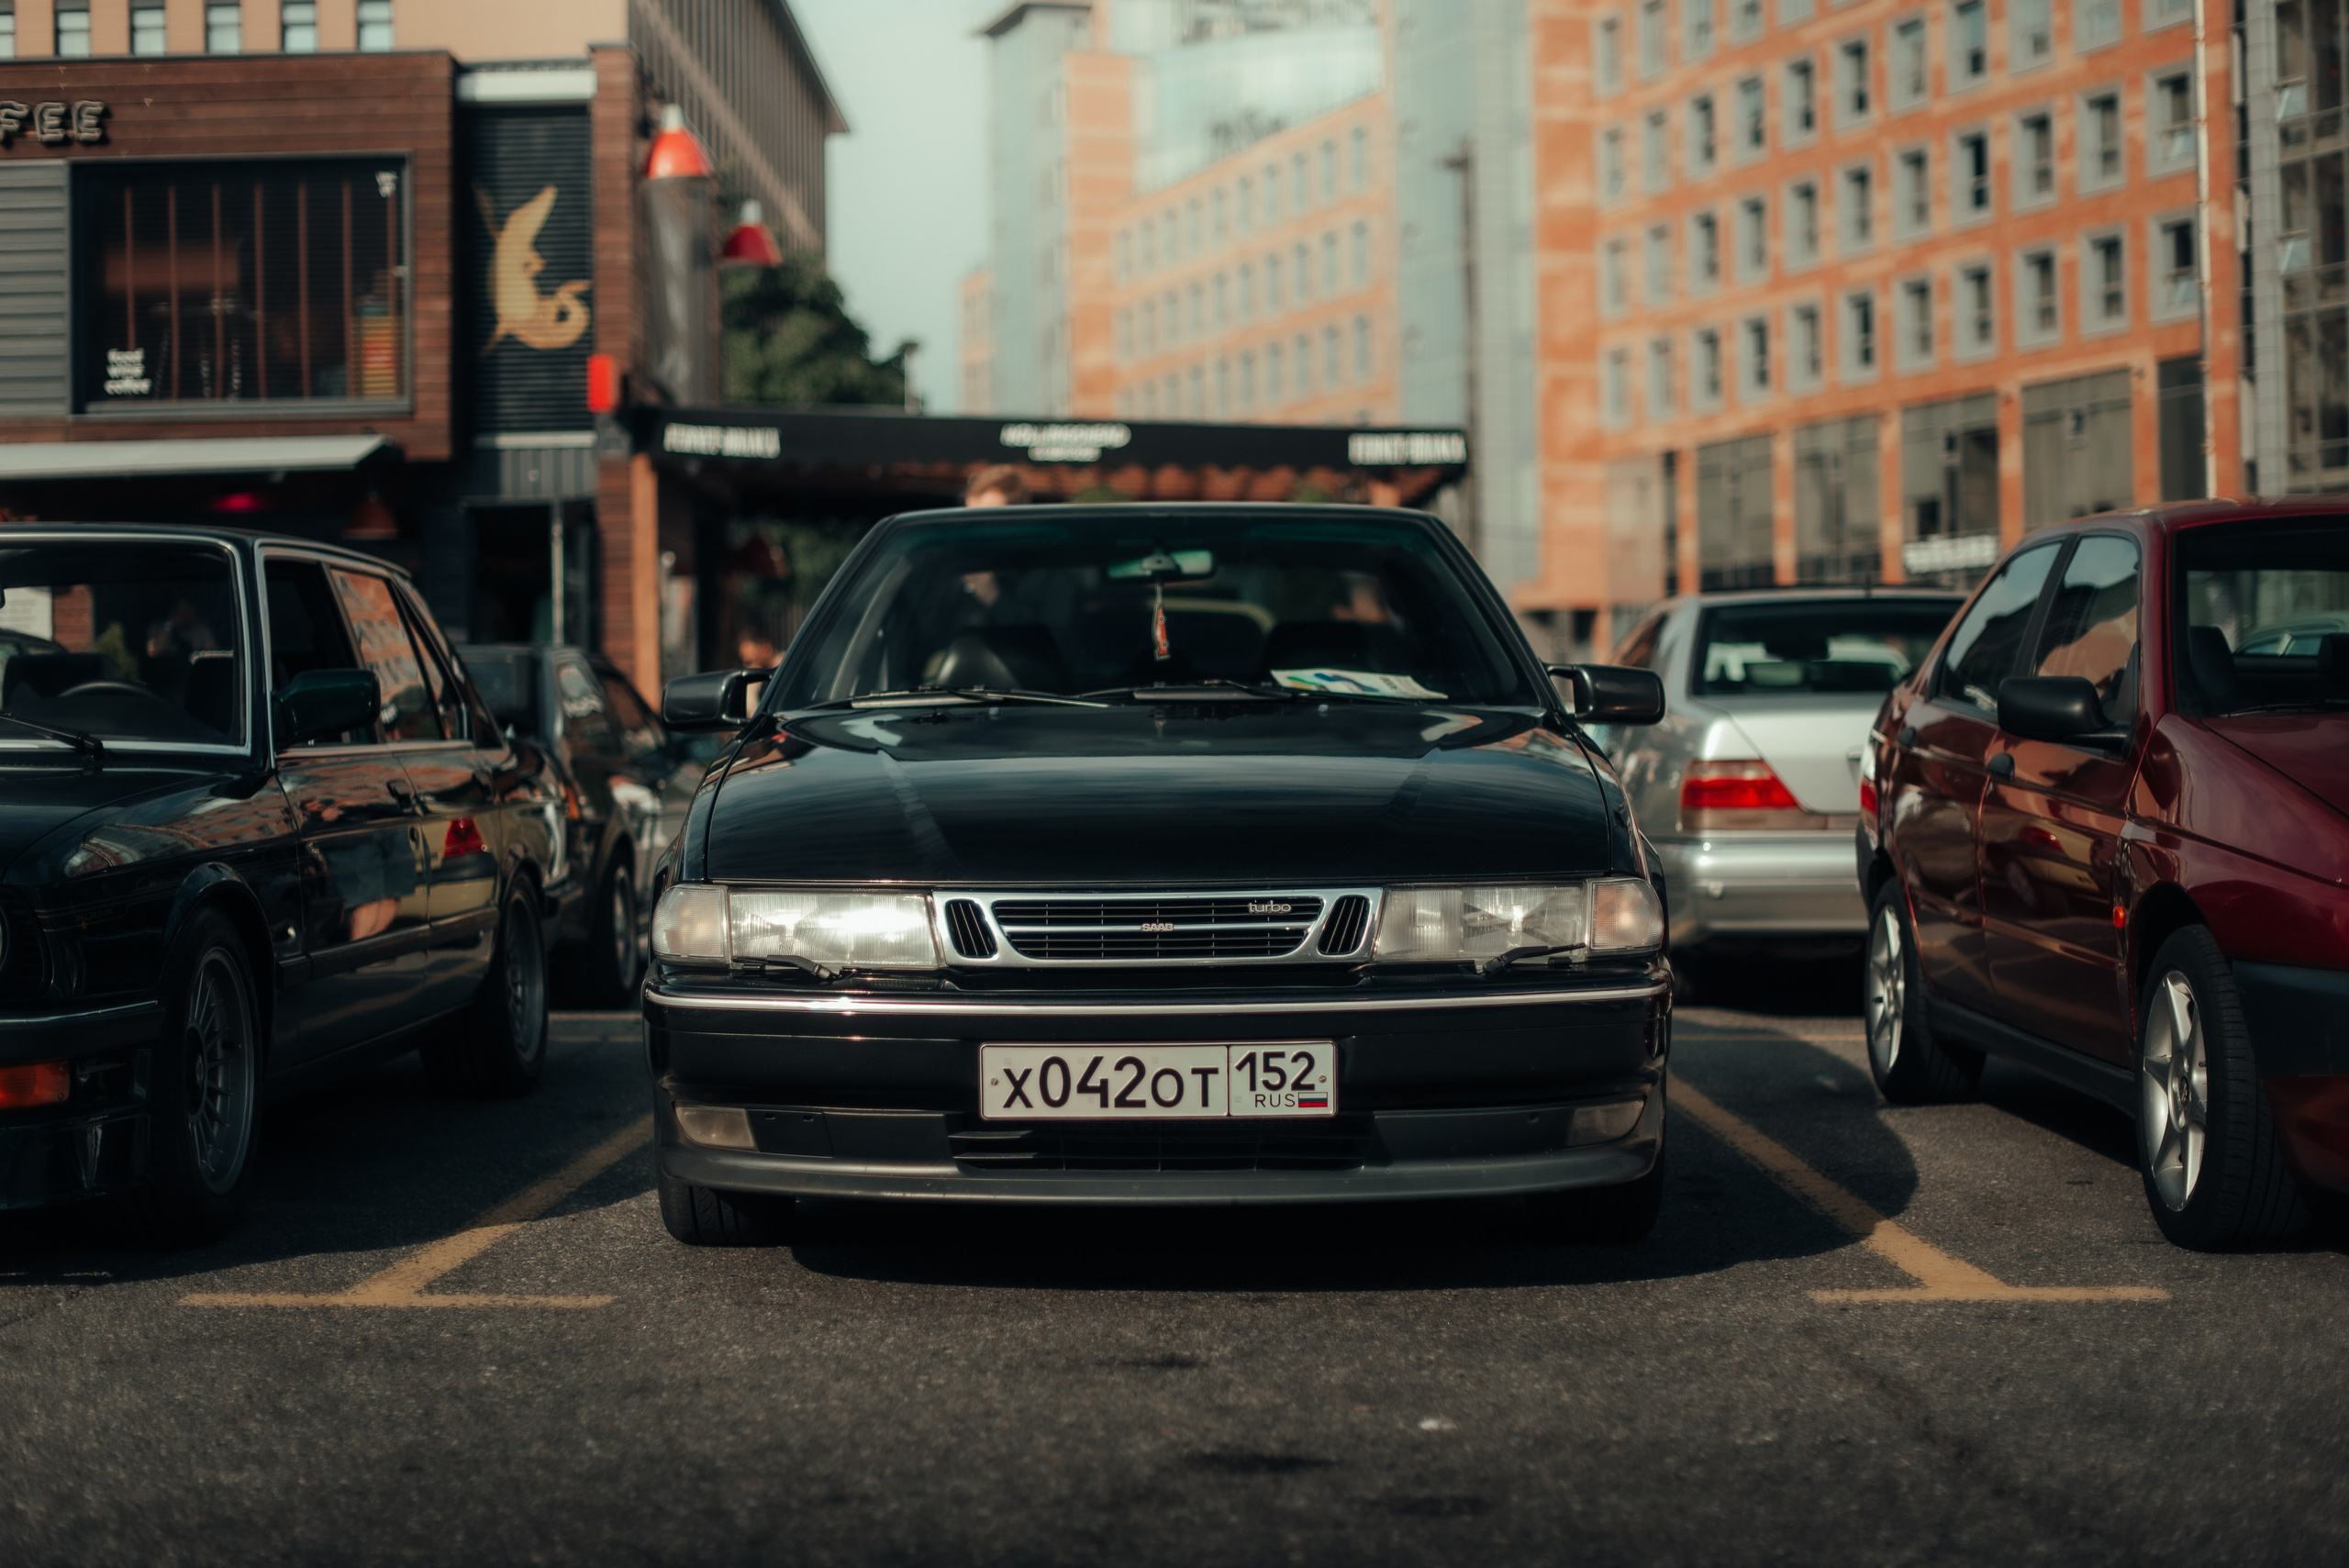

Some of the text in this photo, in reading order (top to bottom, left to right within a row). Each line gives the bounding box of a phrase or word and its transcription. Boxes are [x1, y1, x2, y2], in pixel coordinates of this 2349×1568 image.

[1248, 899, 1292, 914] turbo
[1141, 923, 1174, 932] SAAB
[1234, 1051, 1316, 1092] 152
[1254, 1093, 1297, 1108] RUS
